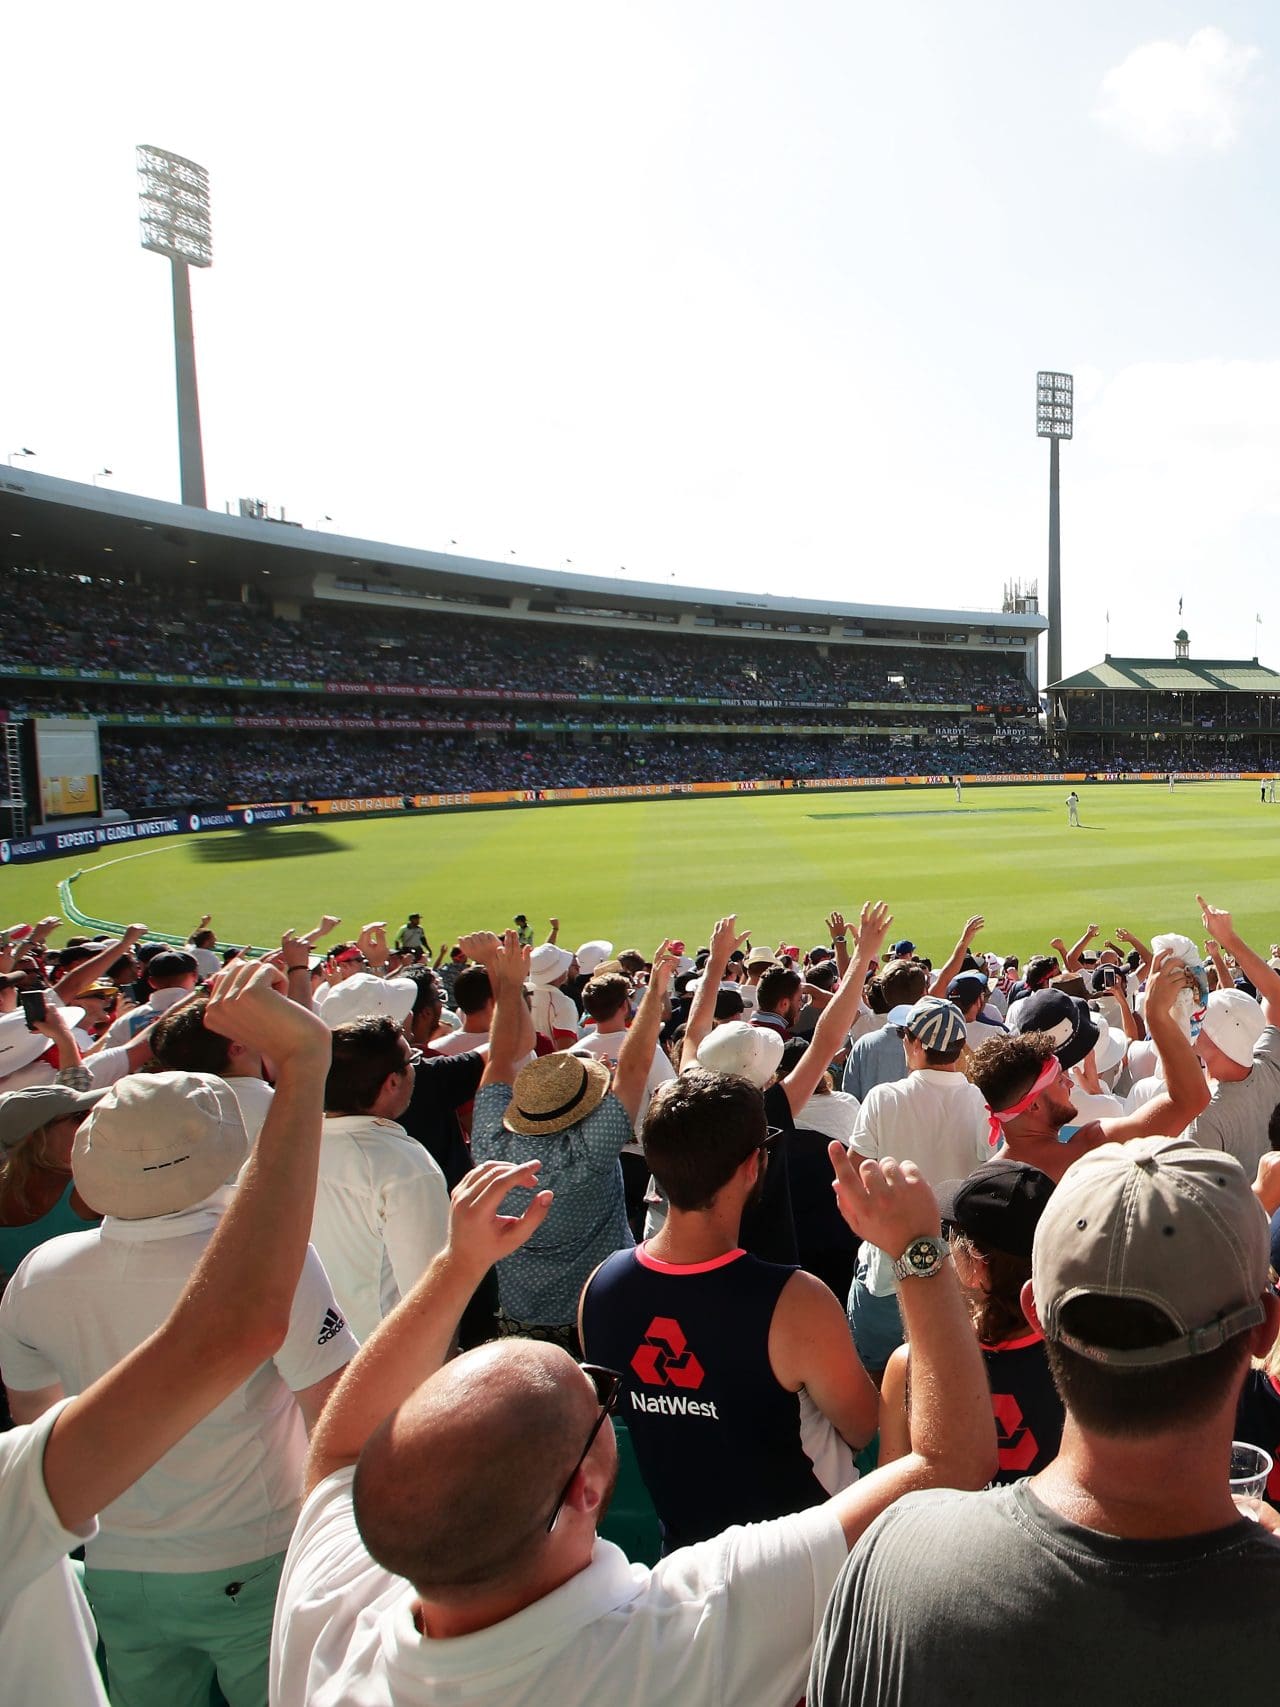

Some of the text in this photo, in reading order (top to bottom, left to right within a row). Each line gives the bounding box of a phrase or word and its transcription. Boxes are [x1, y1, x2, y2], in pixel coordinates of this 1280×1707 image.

[864, 777, 886, 786] BEER
[439, 794, 471, 805] BEER
[56, 830, 95, 849] EXPERTS
[97, 829, 106, 842] IN
[107, 824, 136, 841] GLOBAL
[137, 818, 179, 835] INVESTING
[317, 1319, 345, 1345] adidas
[630, 1391, 720, 1420] NatWest
